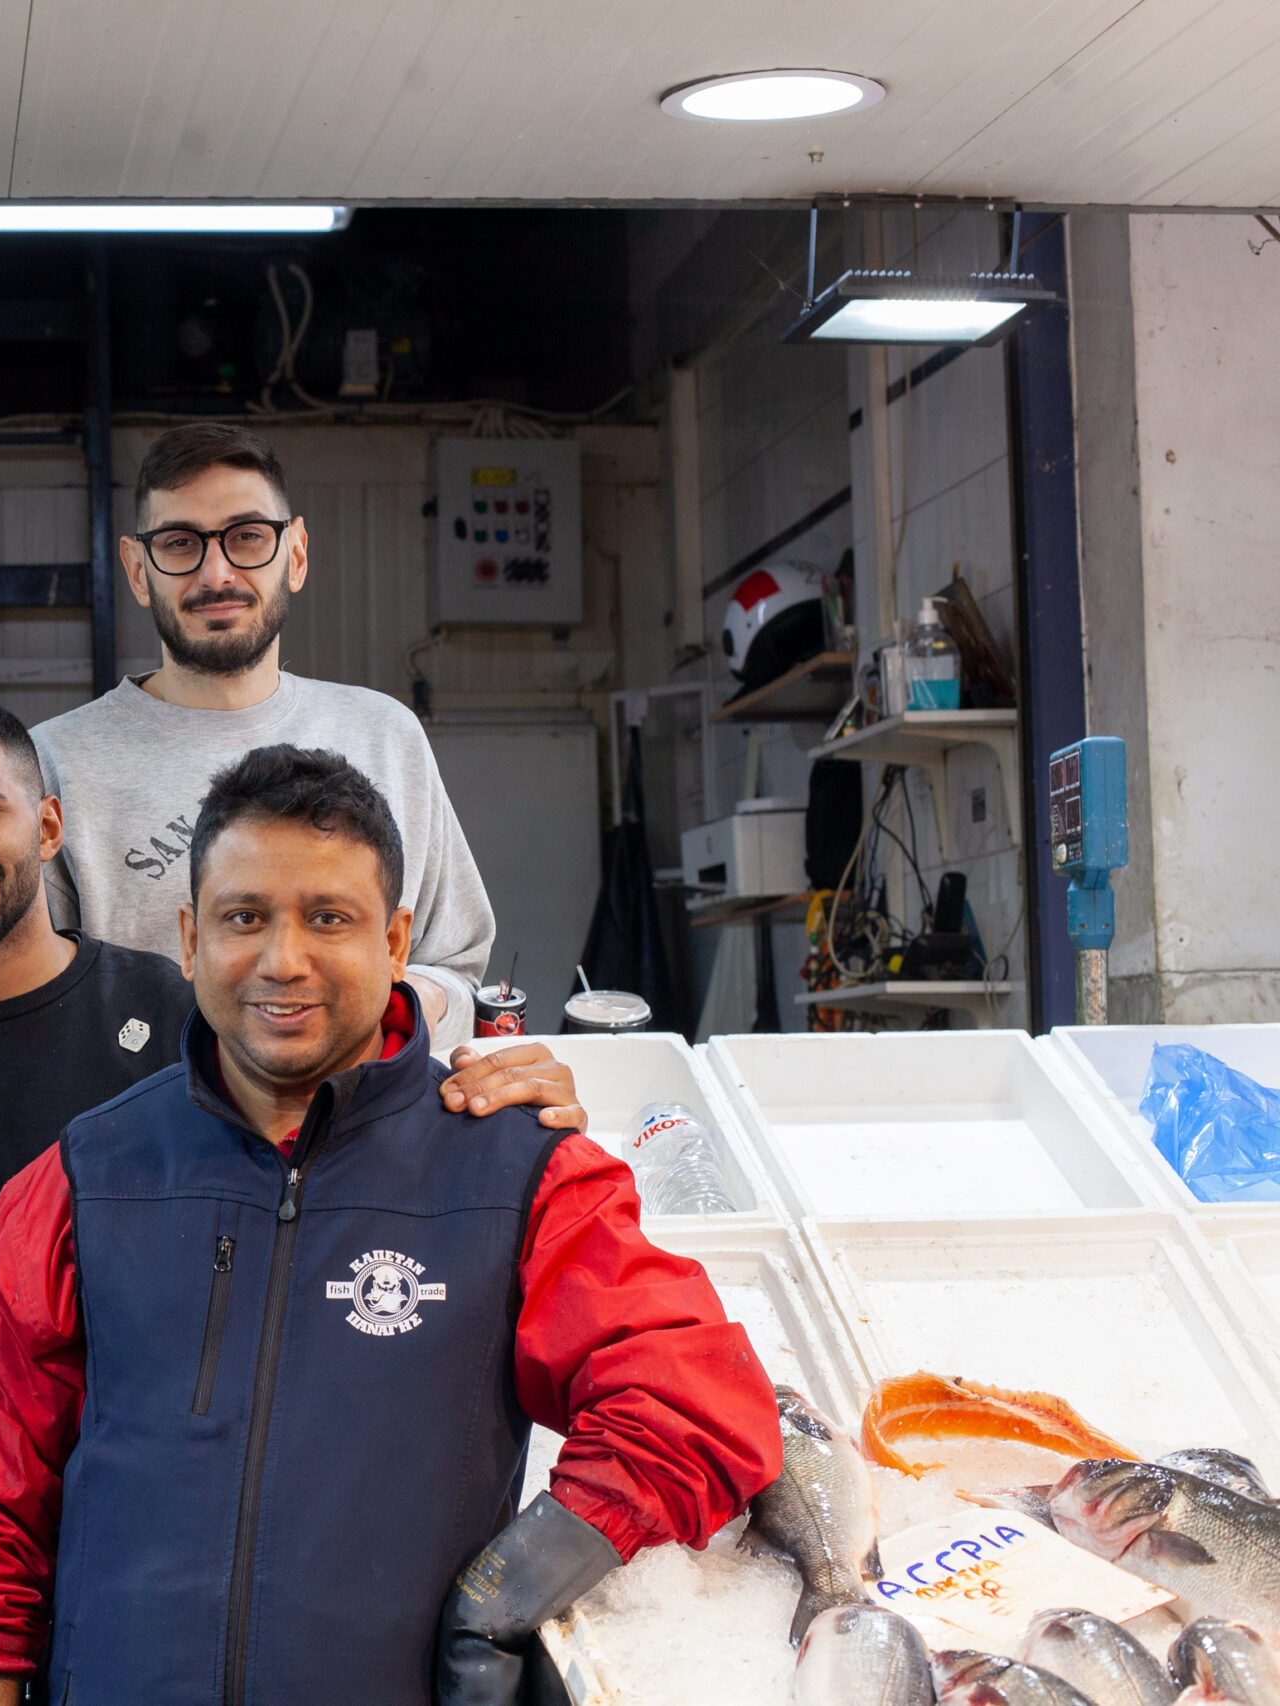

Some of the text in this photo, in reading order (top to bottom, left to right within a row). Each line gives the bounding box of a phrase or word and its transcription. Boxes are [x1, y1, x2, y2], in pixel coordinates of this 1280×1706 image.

[632, 1118, 689, 1149] VIKOS
[329, 1284, 445, 1297] fish trade
